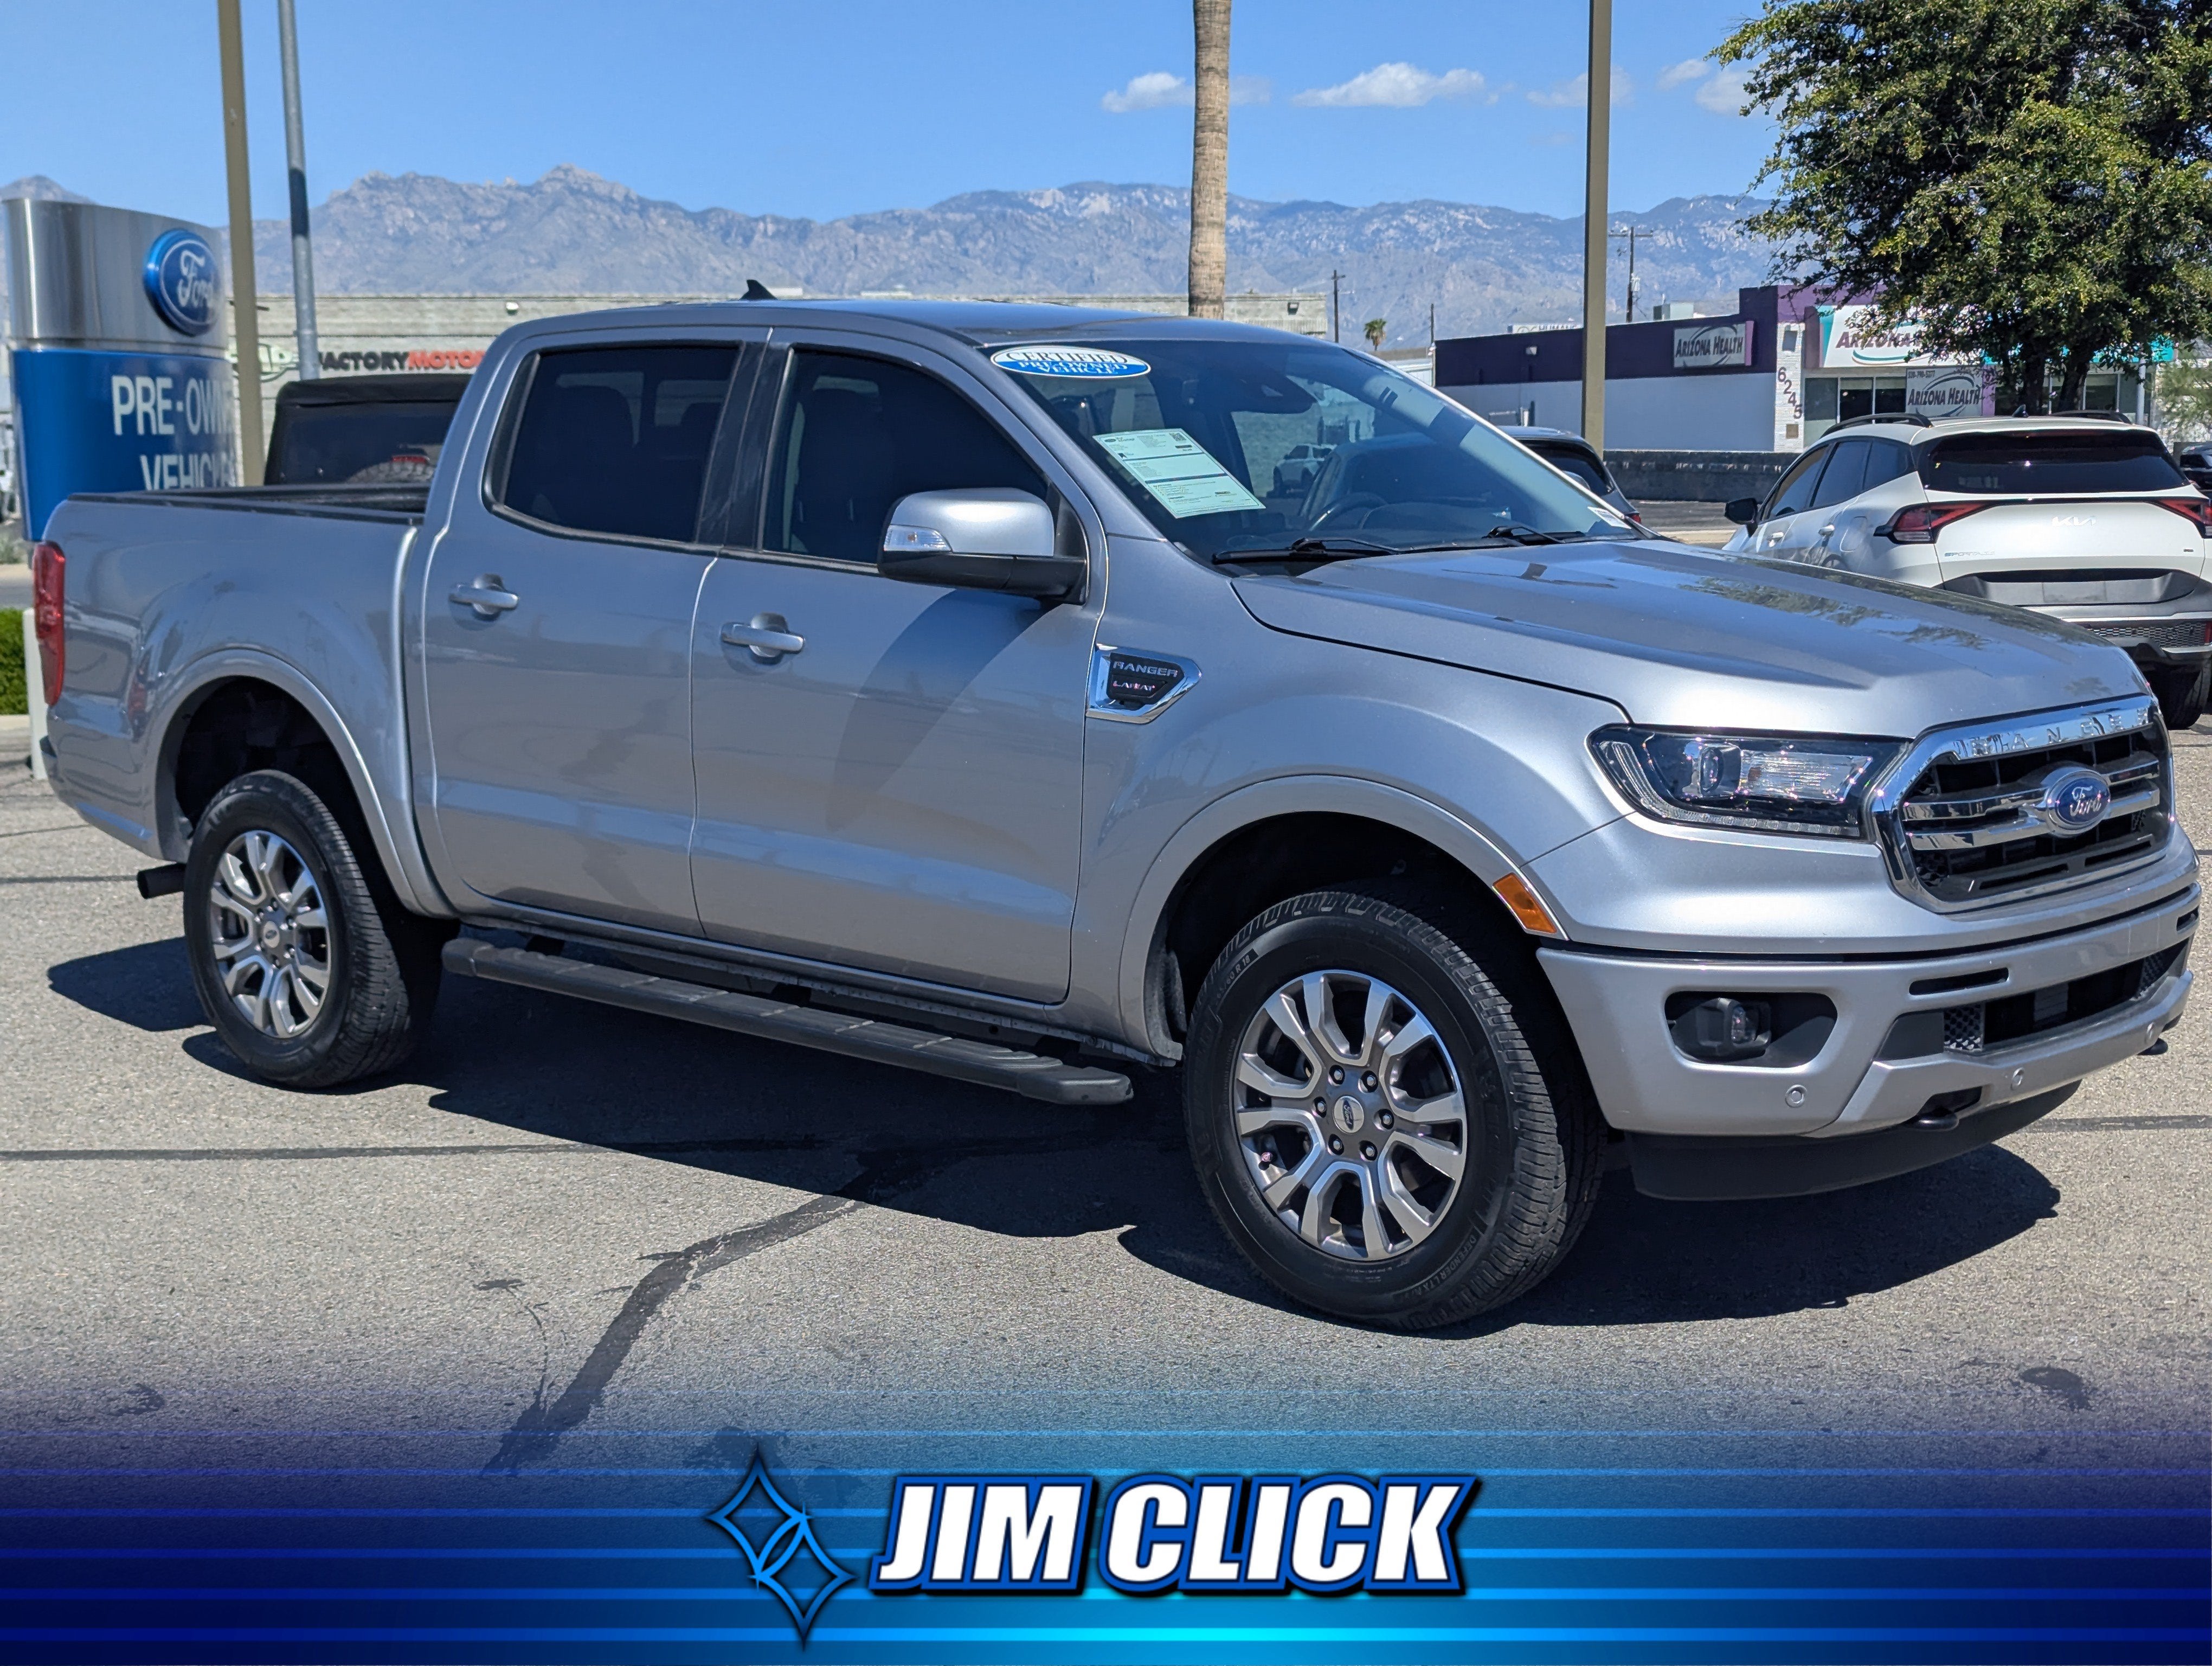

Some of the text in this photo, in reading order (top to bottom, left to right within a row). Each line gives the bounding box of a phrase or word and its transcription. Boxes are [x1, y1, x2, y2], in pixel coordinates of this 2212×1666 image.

[177, 249, 215, 308] Ford
[1675, 335, 1744, 358] ARIZONA HEALTH
[1006, 352, 1128, 364] CERTIFIED
[1038, 366, 1118, 374] VEHICLE
[1778, 367, 1803, 419] 6245
[1908, 387, 1981, 406] ARIZONA HEALTH
[1113, 661, 1178, 678] RANGER
[1113, 681, 1155, 692] LARIAT
[1971, 707, 2149, 756] RANGER
[2069, 785, 2102, 817] Ford
